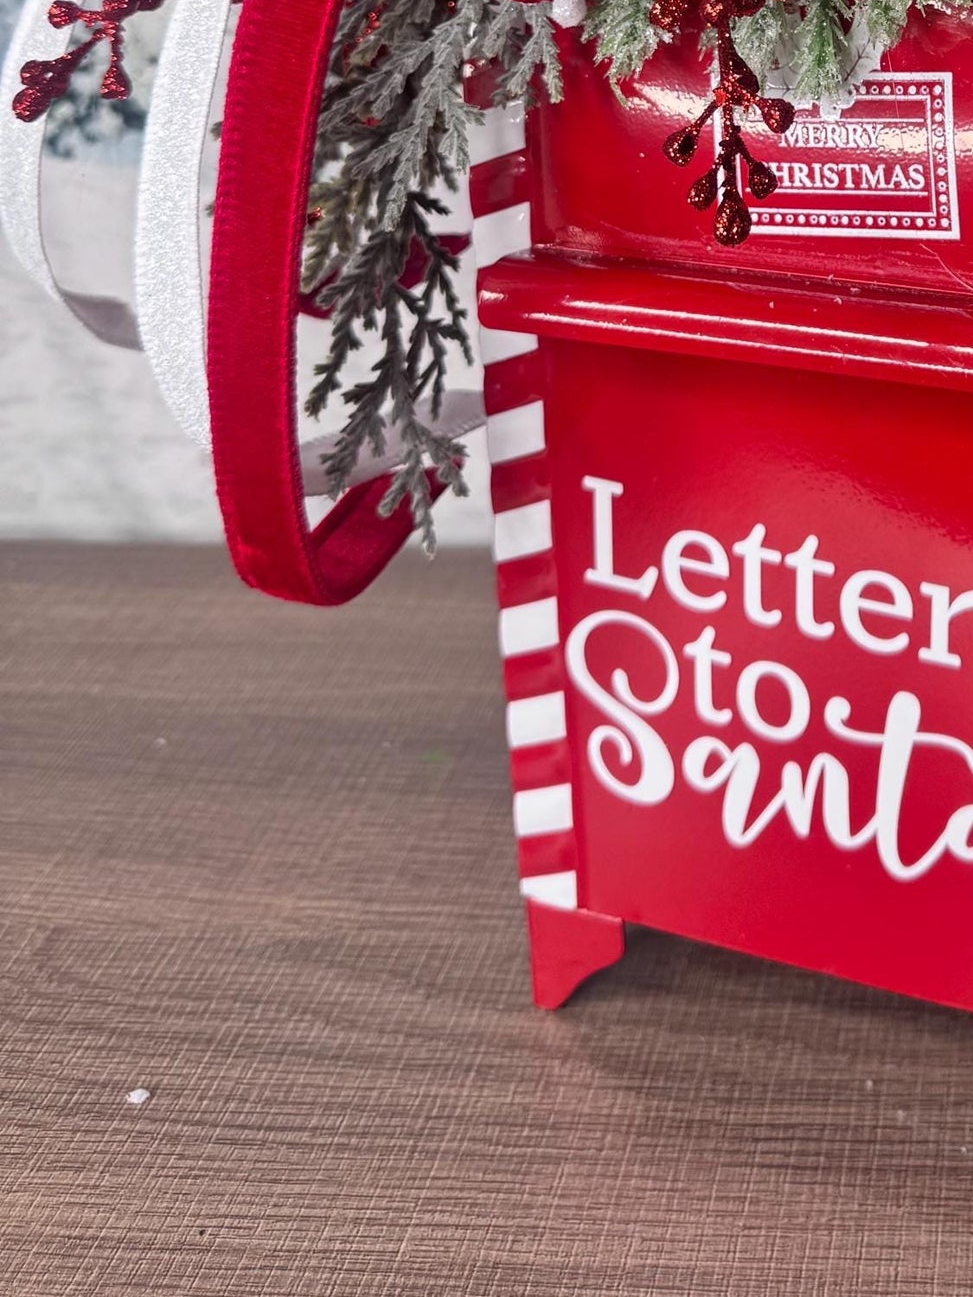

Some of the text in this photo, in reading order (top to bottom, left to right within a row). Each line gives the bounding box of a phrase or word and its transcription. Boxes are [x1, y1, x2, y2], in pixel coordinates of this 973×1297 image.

[778, 122, 884, 148] MERRY
[762, 161, 926, 190] HRISTMAS
[683, 625, 811, 742] to
